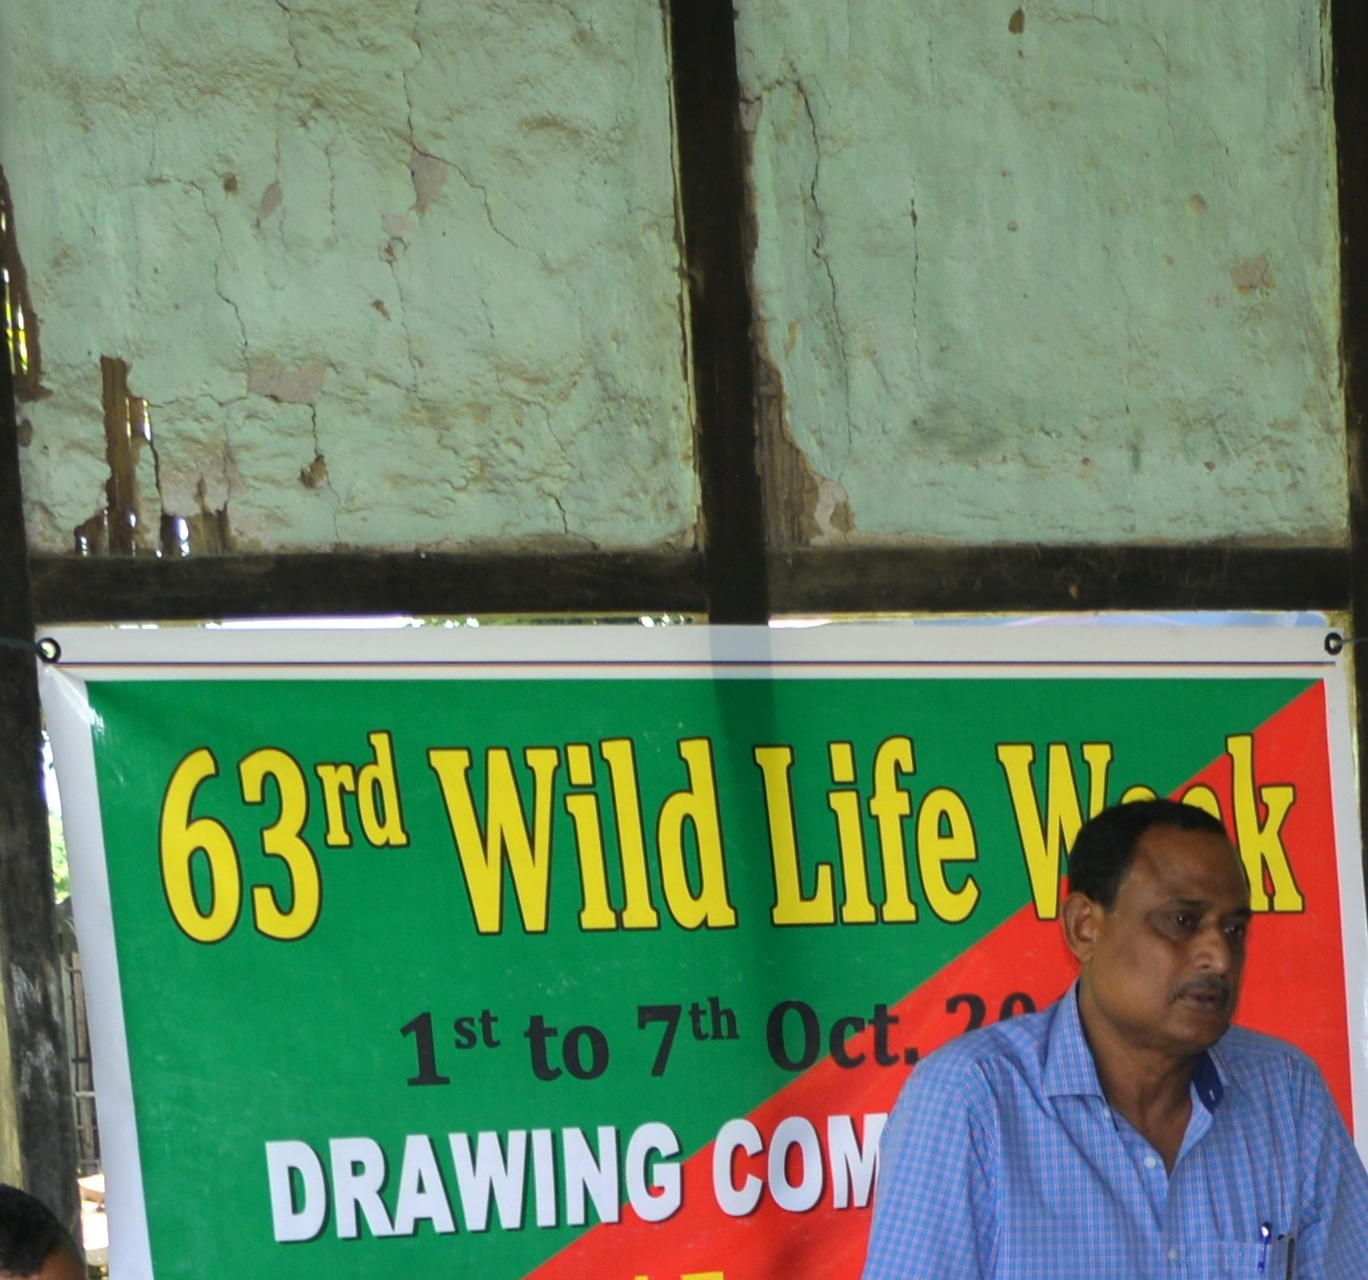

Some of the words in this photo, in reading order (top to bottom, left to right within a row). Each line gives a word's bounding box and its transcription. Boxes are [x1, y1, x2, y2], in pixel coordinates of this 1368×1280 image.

[158, 730, 410, 946] 63rd
[427, 737, 738, 936] Wild
[752, 734, 981, 927] Life
[995, 732, 1305, 922] Wk
[399, 1007, 501, 1087] 1st
[524, 1014, 610, 1083] to
[636, 997, 740, 1078] 7th
[766, 999, 920, 1073] Oct.
[265, 1121, 684, 1243] DRAWING
